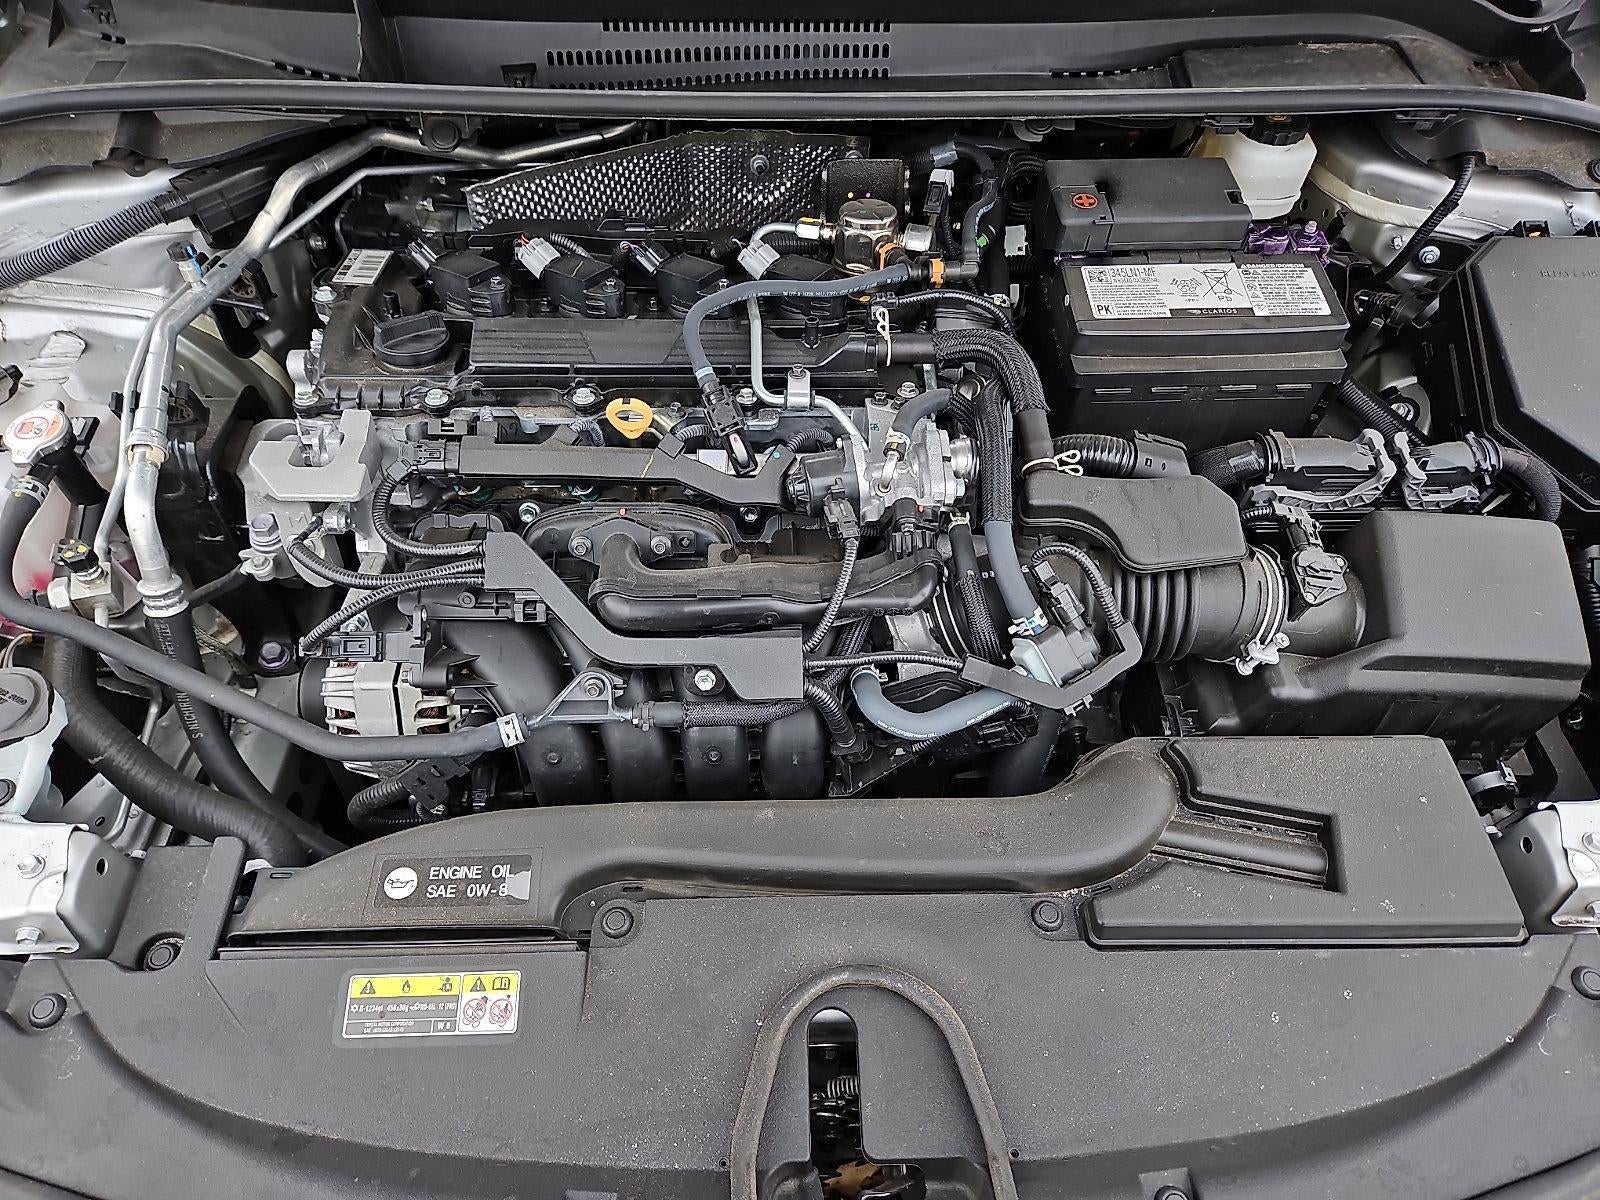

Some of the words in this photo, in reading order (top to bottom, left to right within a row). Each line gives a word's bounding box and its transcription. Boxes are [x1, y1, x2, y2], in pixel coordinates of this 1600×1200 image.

[1097, 304, 1113, 315] PK
[428, 865, 483, 880] ENGINE
[491, 864, 515, 878] OIL
[426, 884, 457, 898] SAE
